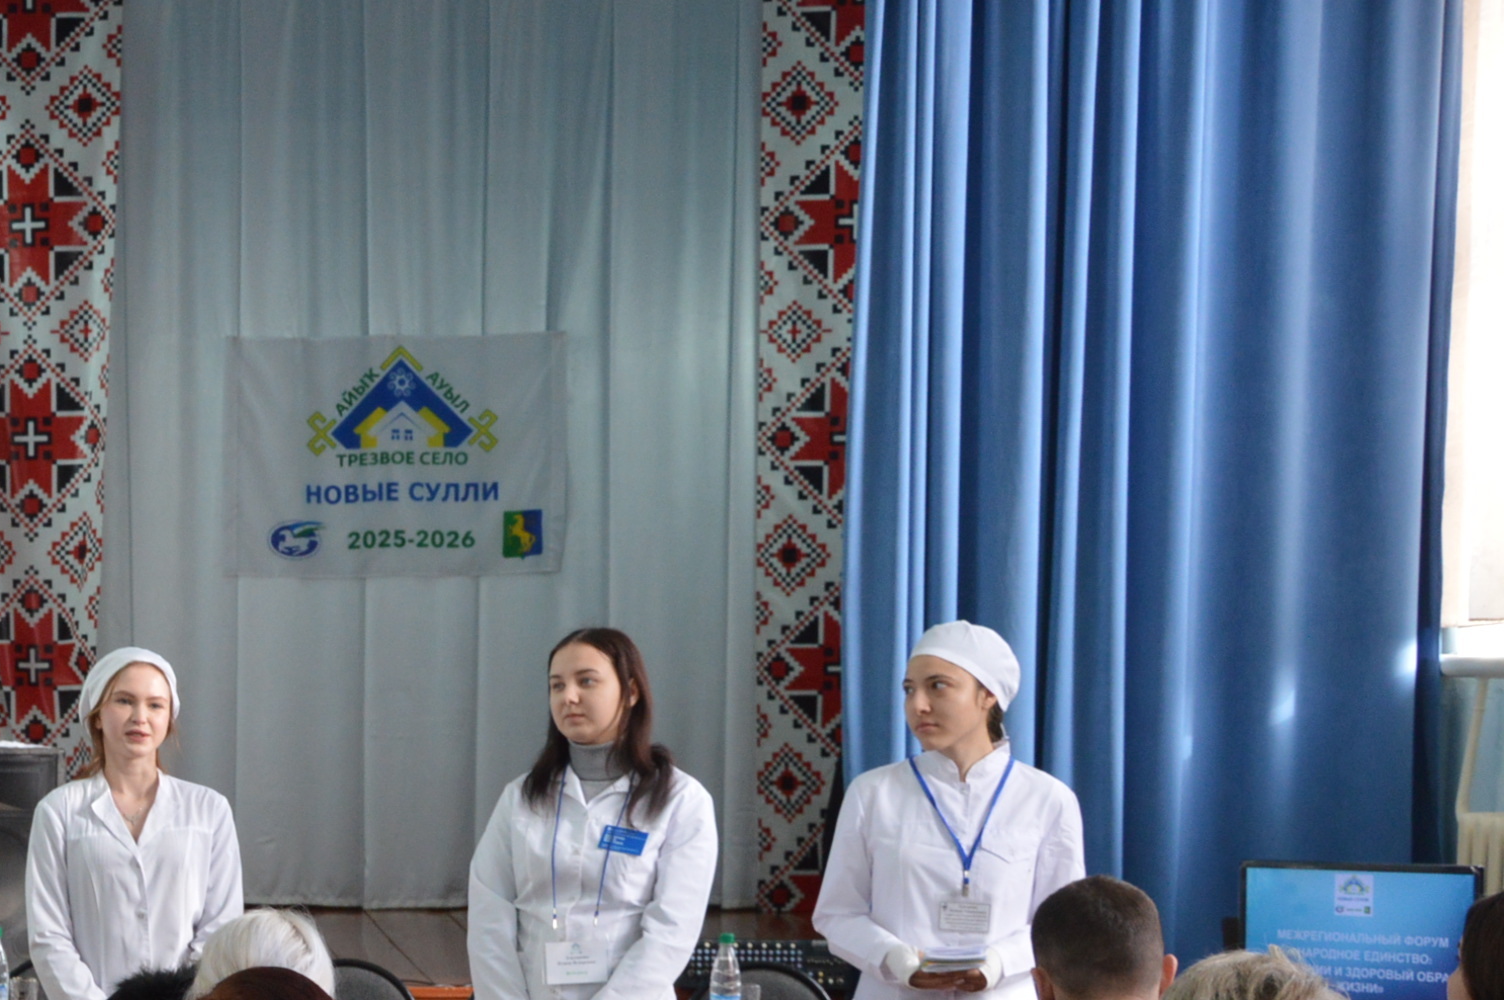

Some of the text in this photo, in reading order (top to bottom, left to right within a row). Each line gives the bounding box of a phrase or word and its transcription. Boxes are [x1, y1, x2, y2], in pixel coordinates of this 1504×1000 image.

[425, 371, 471, 415] АУЫЛ
[336, 451, 469, 467] ТРЕЗВОЕ СЕЛО
[305, 481, 499, 504] НОВЫЕ СУЛЛИ
[348, 529, 476, 550] 2025-2026
[1277, 929, 1449, 949] МЕЖРЕГИОНАЛЬНЫЙ ФОРУМ
[1346, 966, 1414, 982] ЗДОРОВЫЙ
[1416, 970, 1449, 983] ОБРА
